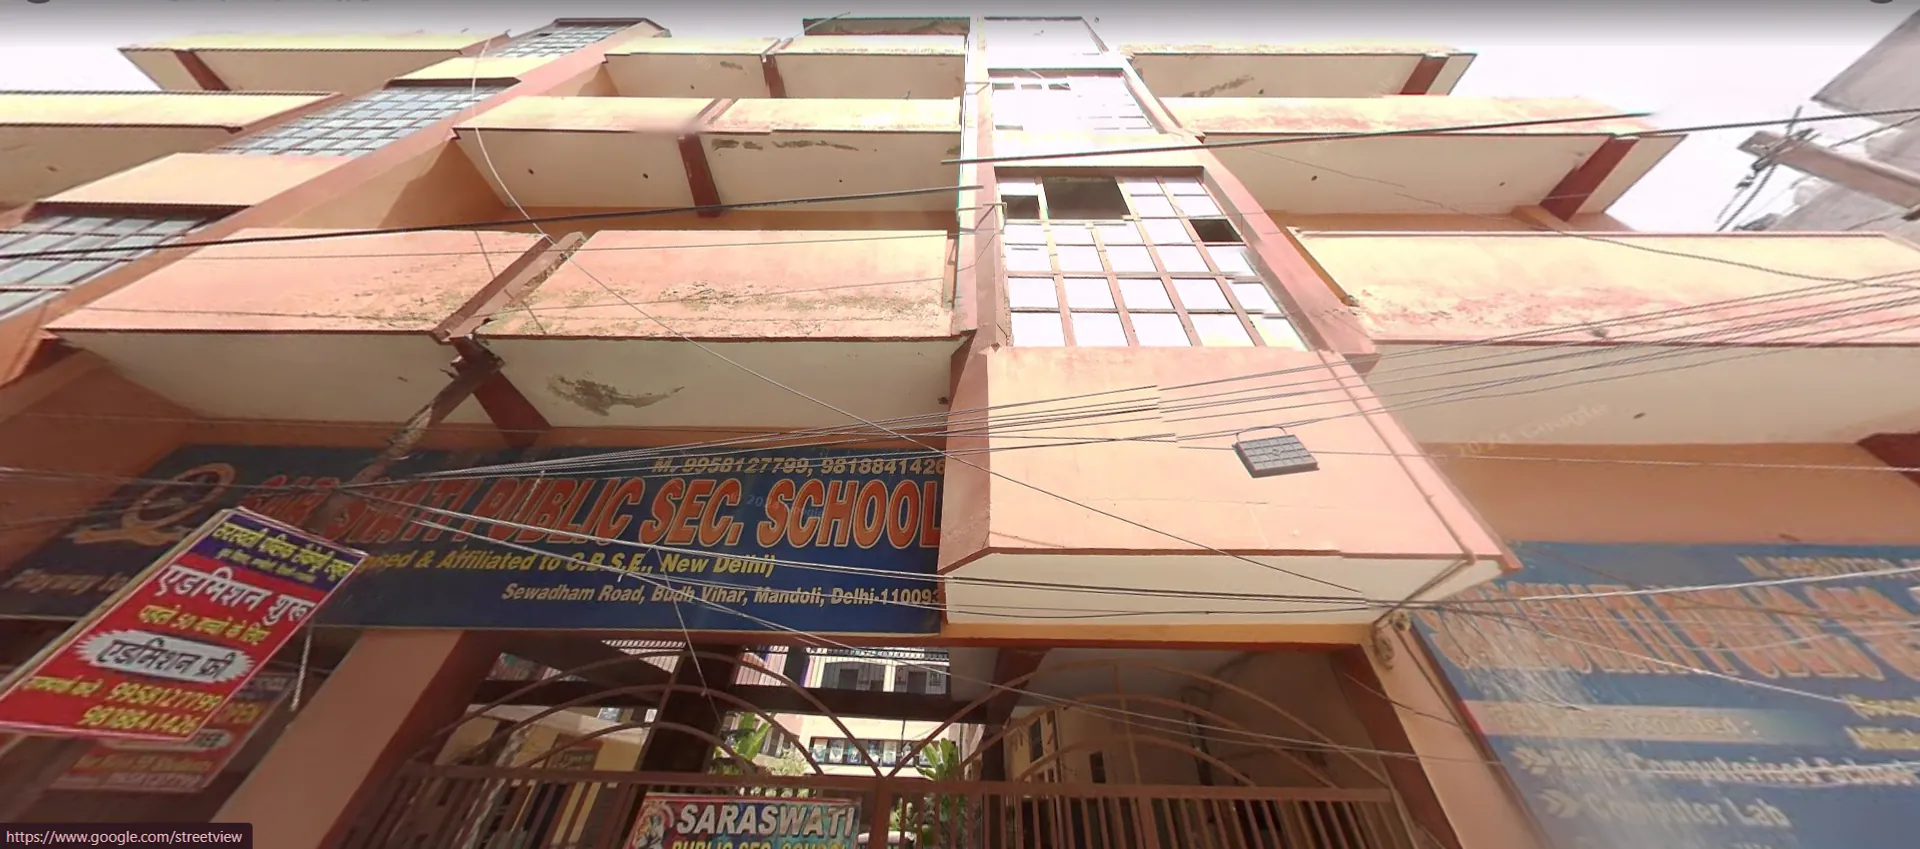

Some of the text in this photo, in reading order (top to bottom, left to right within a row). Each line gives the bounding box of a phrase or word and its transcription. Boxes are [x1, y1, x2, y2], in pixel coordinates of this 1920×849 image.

[452, 477, 645, 545] PUBLIC
[637, 478, 744, 546] SEC.
[756, 479, 942, 549] SCHOOL
[414, 550, 435, 569] &
[436, 548, 538, 570] Affiliated
[538, 553, 561, 571] to
[660, 553, 709, 573] New
[712, 555, 776, 577] Delhi)
[155, 564, 274, 611] एडमिशन
[502, 583, 594, 600] Sewadham
[597, 584, 645, 605] Road,
[652, 586, 696, 603] Budh
[700, 586, 749, 606] Vihar,
[753, 586, 825, 607] Mandoli,
[97, 637, 200, 676] एडमिशन
[676, 803, 856, 838] SARASWATI
[1719, 797, 1793, 828] Lab
